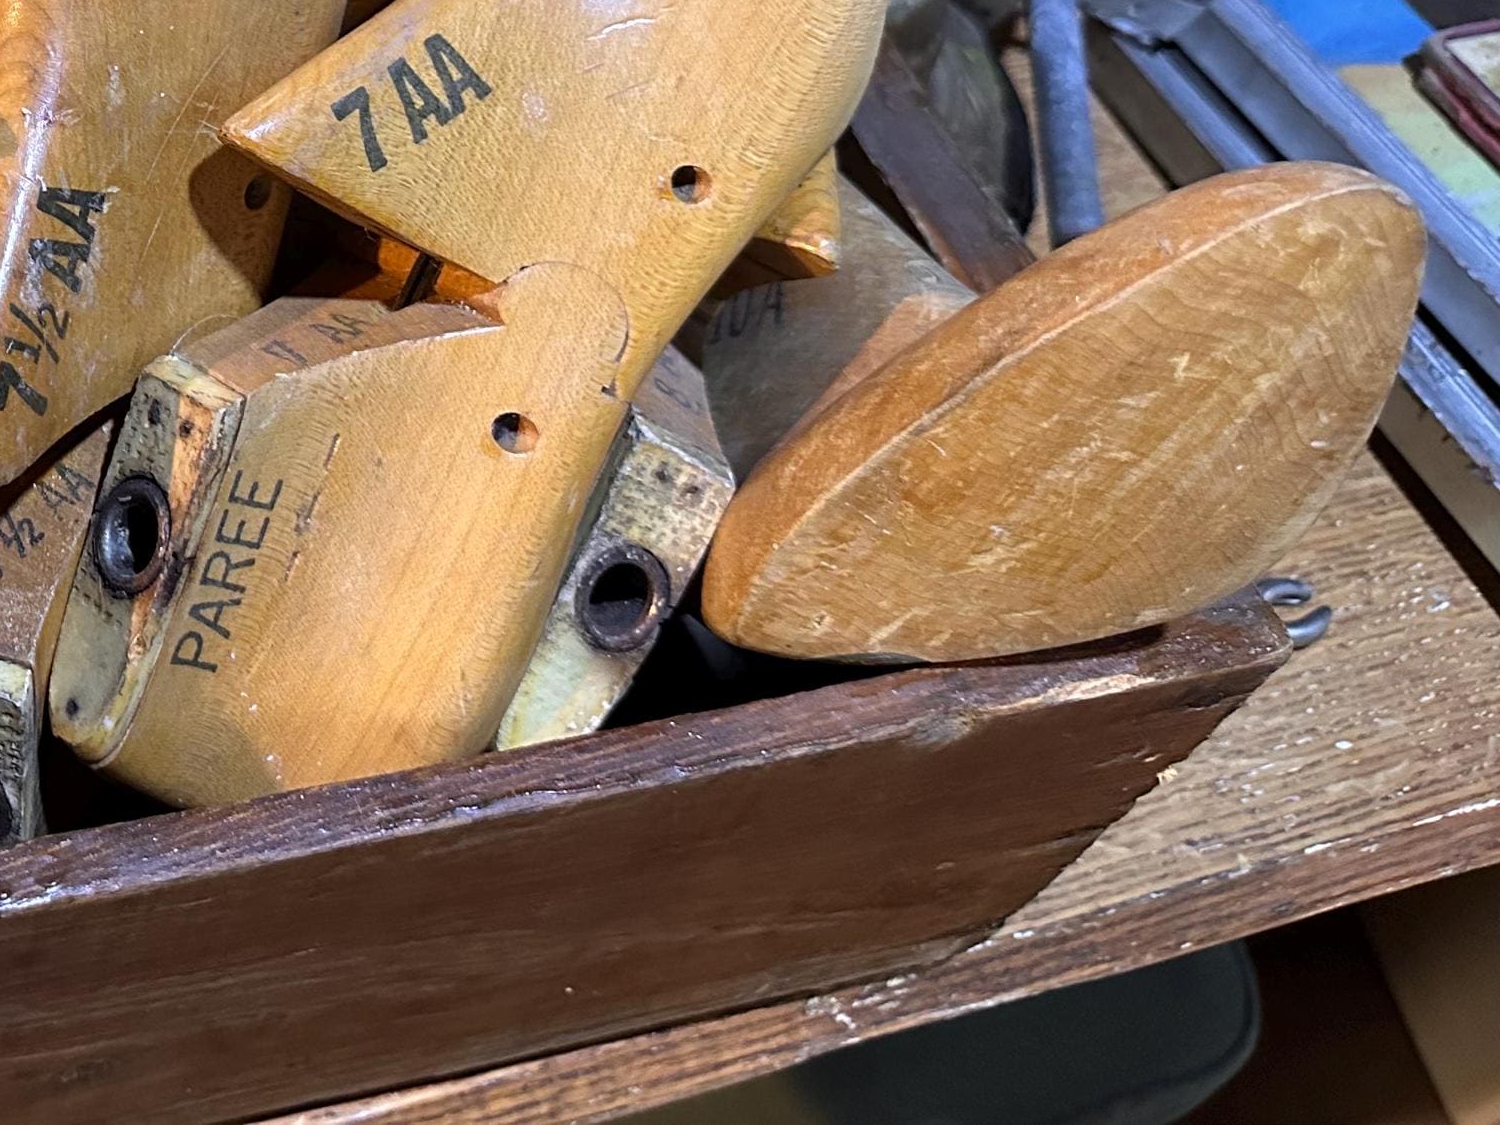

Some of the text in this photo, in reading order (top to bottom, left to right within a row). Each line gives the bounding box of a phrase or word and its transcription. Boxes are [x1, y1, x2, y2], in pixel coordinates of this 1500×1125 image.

[331, 32, 492, 173] 7 AA
[28, 185, 107, 294] AA
[171, 469, 285, 673] PAREE
